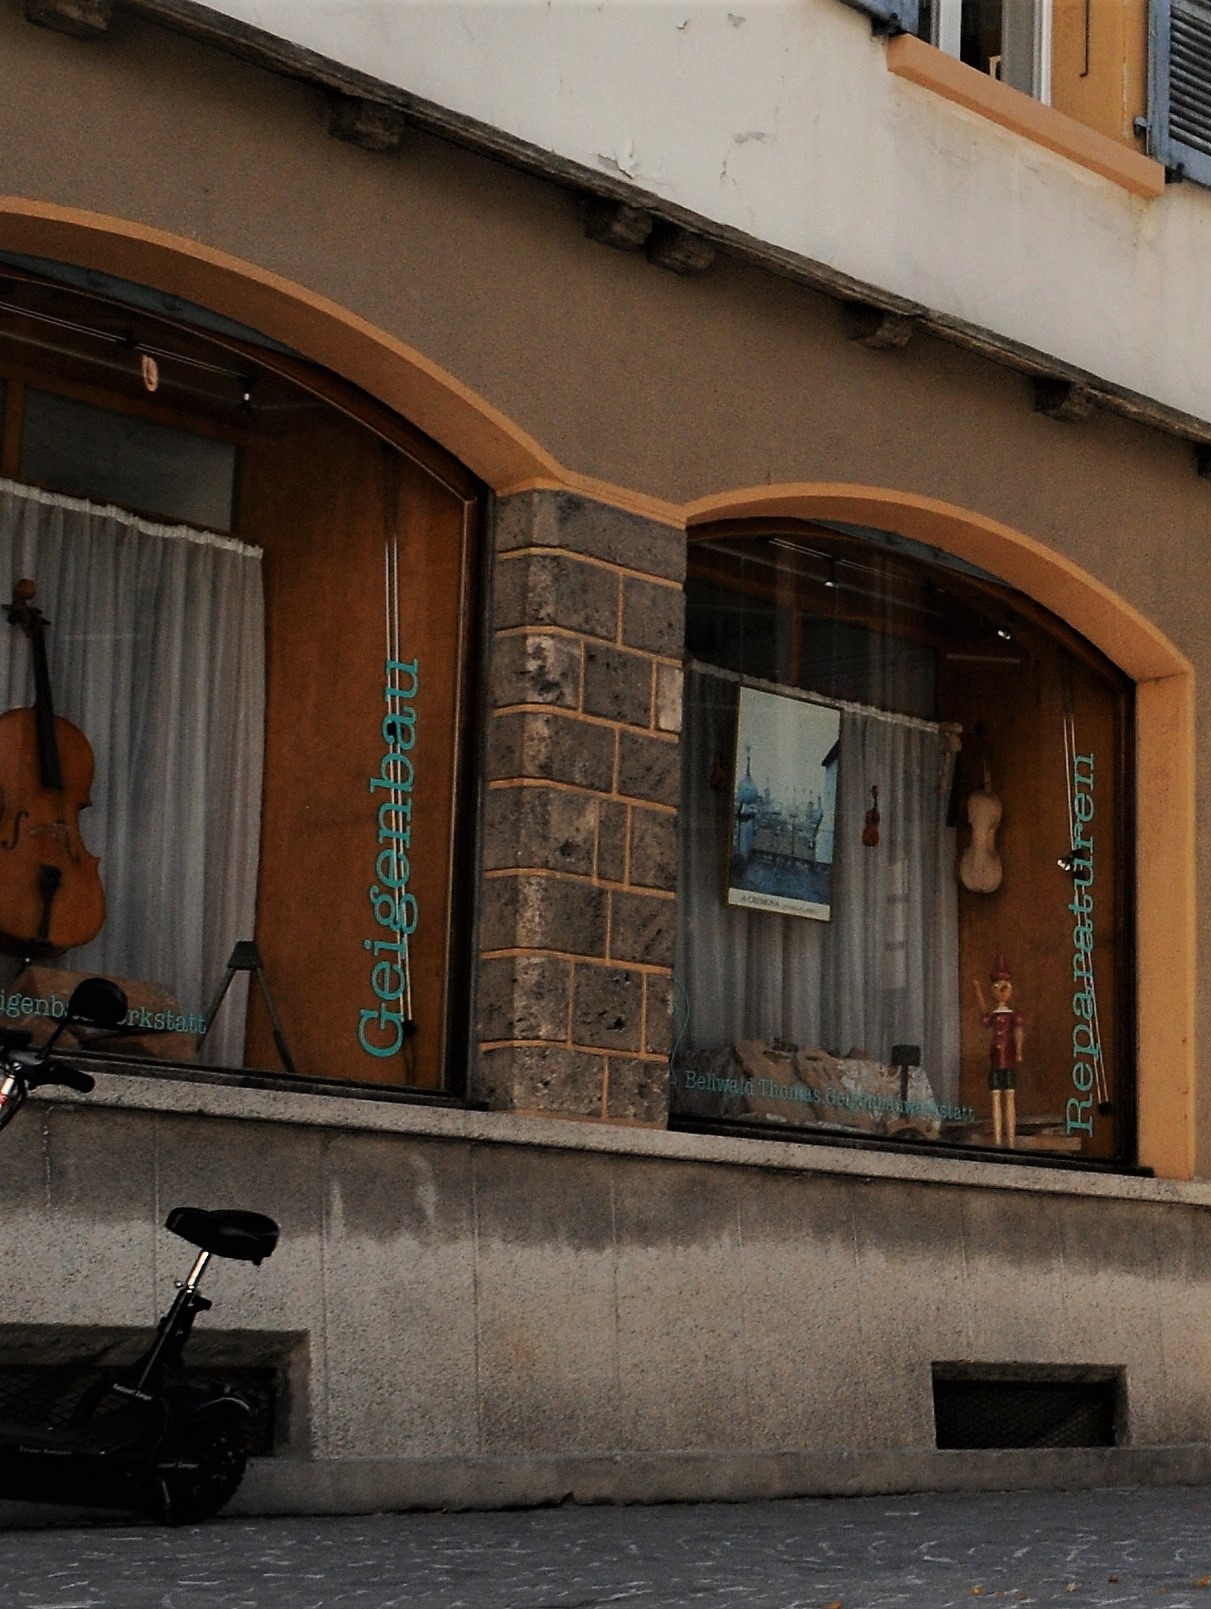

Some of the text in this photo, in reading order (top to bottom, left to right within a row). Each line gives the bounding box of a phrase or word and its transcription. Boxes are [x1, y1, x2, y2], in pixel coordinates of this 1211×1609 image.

[357, 657, 419, 1058] Geigenbau
[1064, 752, 1098, 1138] Reparaturen
[758, 1078, 821, 1103] Thomas
